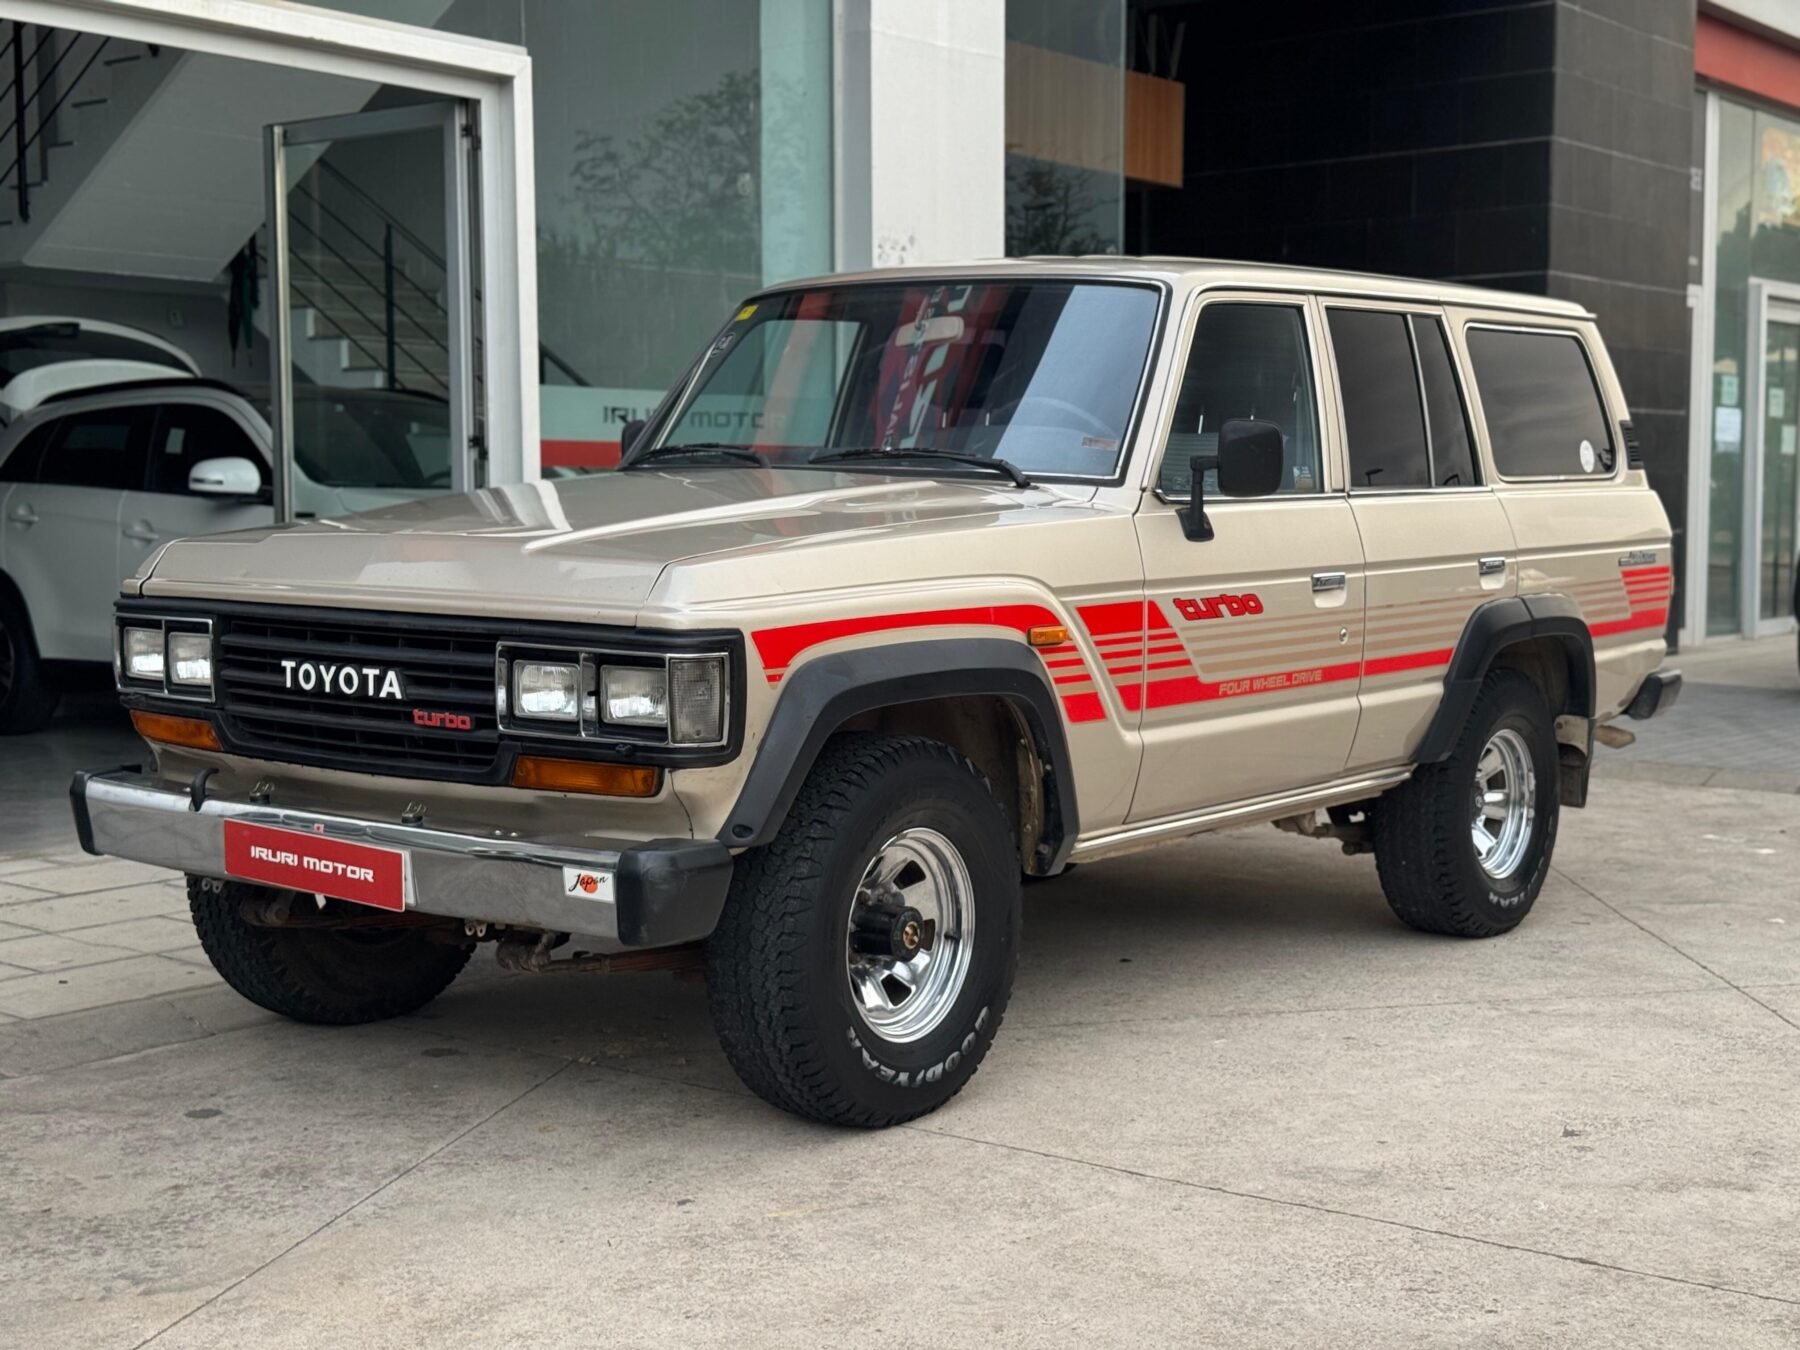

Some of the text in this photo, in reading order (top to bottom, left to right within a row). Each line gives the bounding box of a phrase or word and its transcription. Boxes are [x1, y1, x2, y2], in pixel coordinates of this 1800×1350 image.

[1173, 594, 1264, 621] turbo
[281, 660, 402, 699] TOYOTA
[1218, 669, 1323, 696] FOUR WHEEL DRIVE
[413, 708, 471, 730] turbo
[250, 845, 374, 882] IRURI MOTOR
[568, 873, 609, 892] Japan
